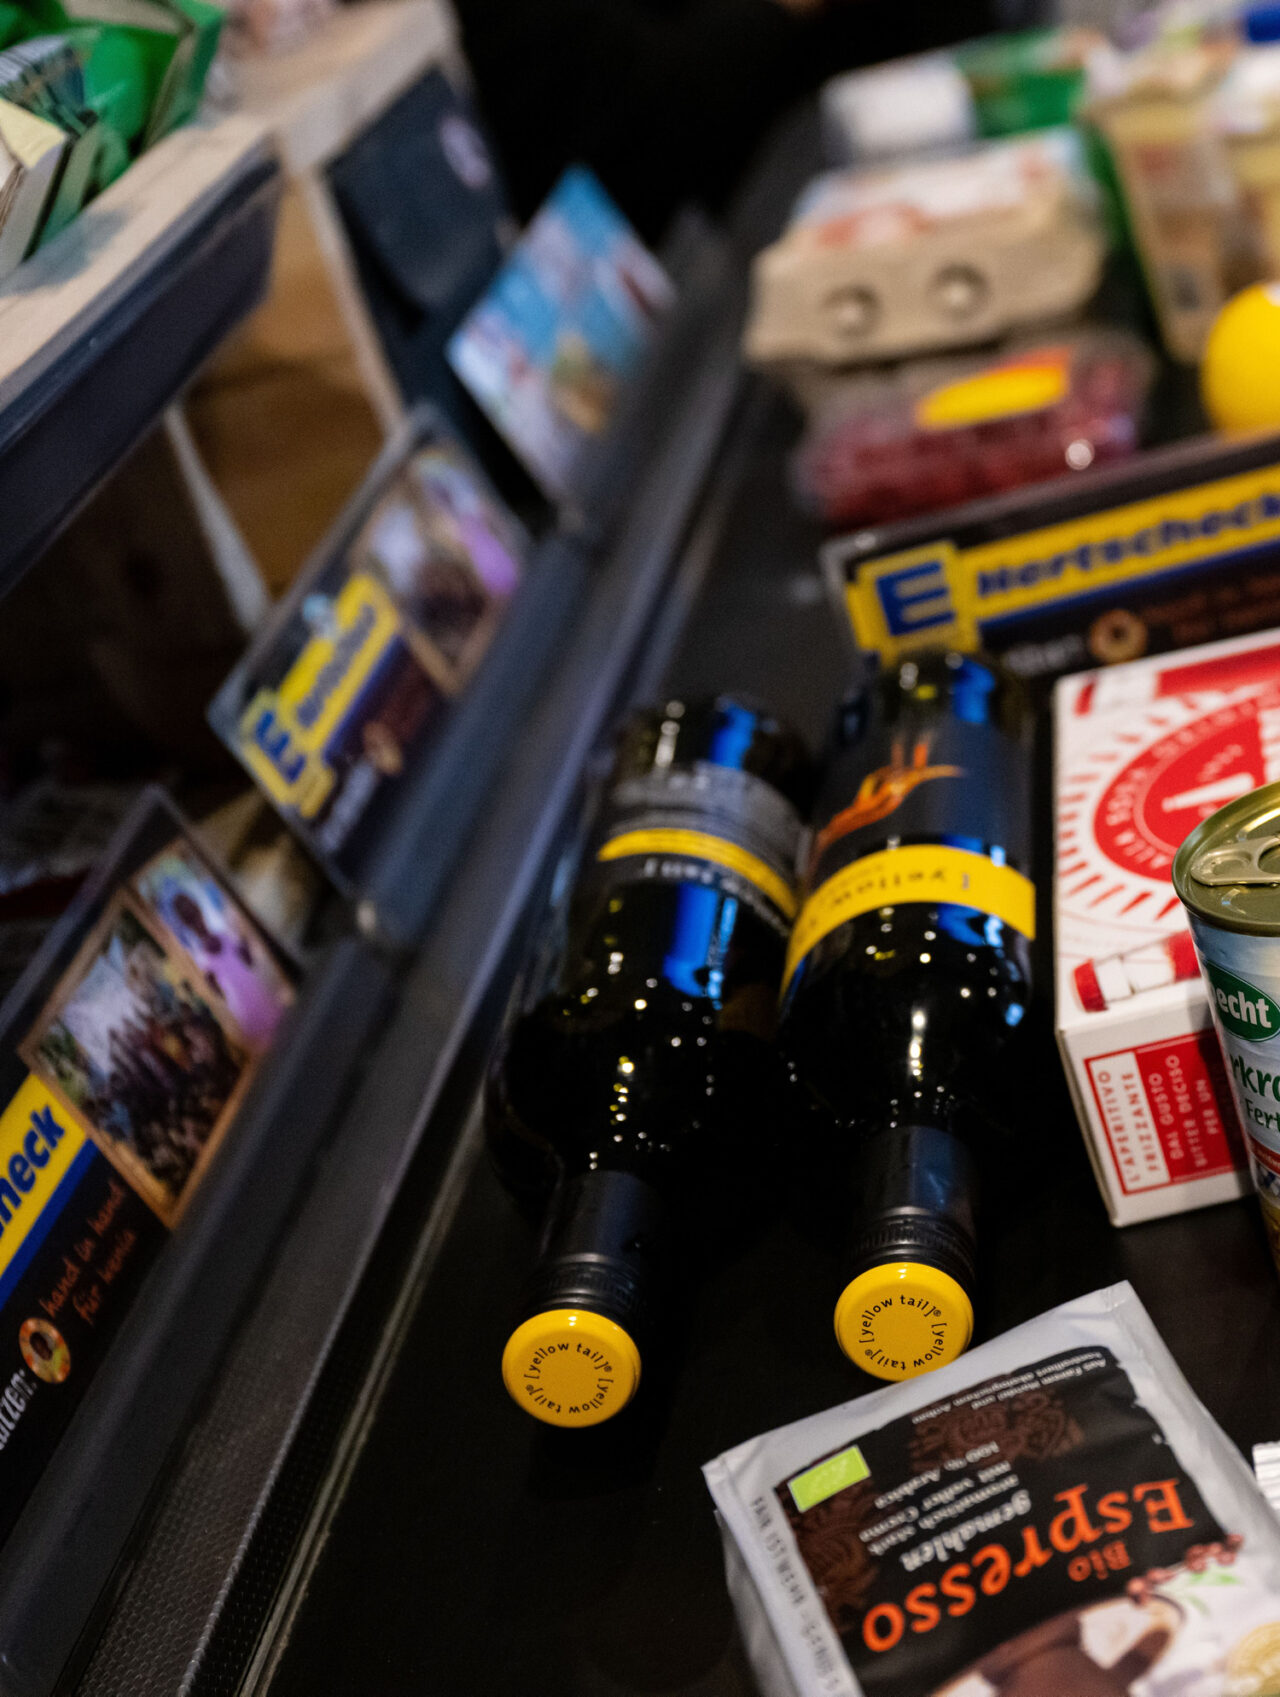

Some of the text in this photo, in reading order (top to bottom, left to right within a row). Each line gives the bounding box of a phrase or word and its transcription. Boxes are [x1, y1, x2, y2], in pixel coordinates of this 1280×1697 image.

[1214, 984, 1272, 1029] echt
[1121, 1073, 1159, 1171] FRIZZANTE
[1148, 1073, 1174, 1125] GUSTO
[0, 1105, 66, 1240] heck
[863, 1479, 1194, 1652] Espresso
[900, 1487, 1033, 1571] gemahlen
[1067, 1540, 1131, 1582] Bio
